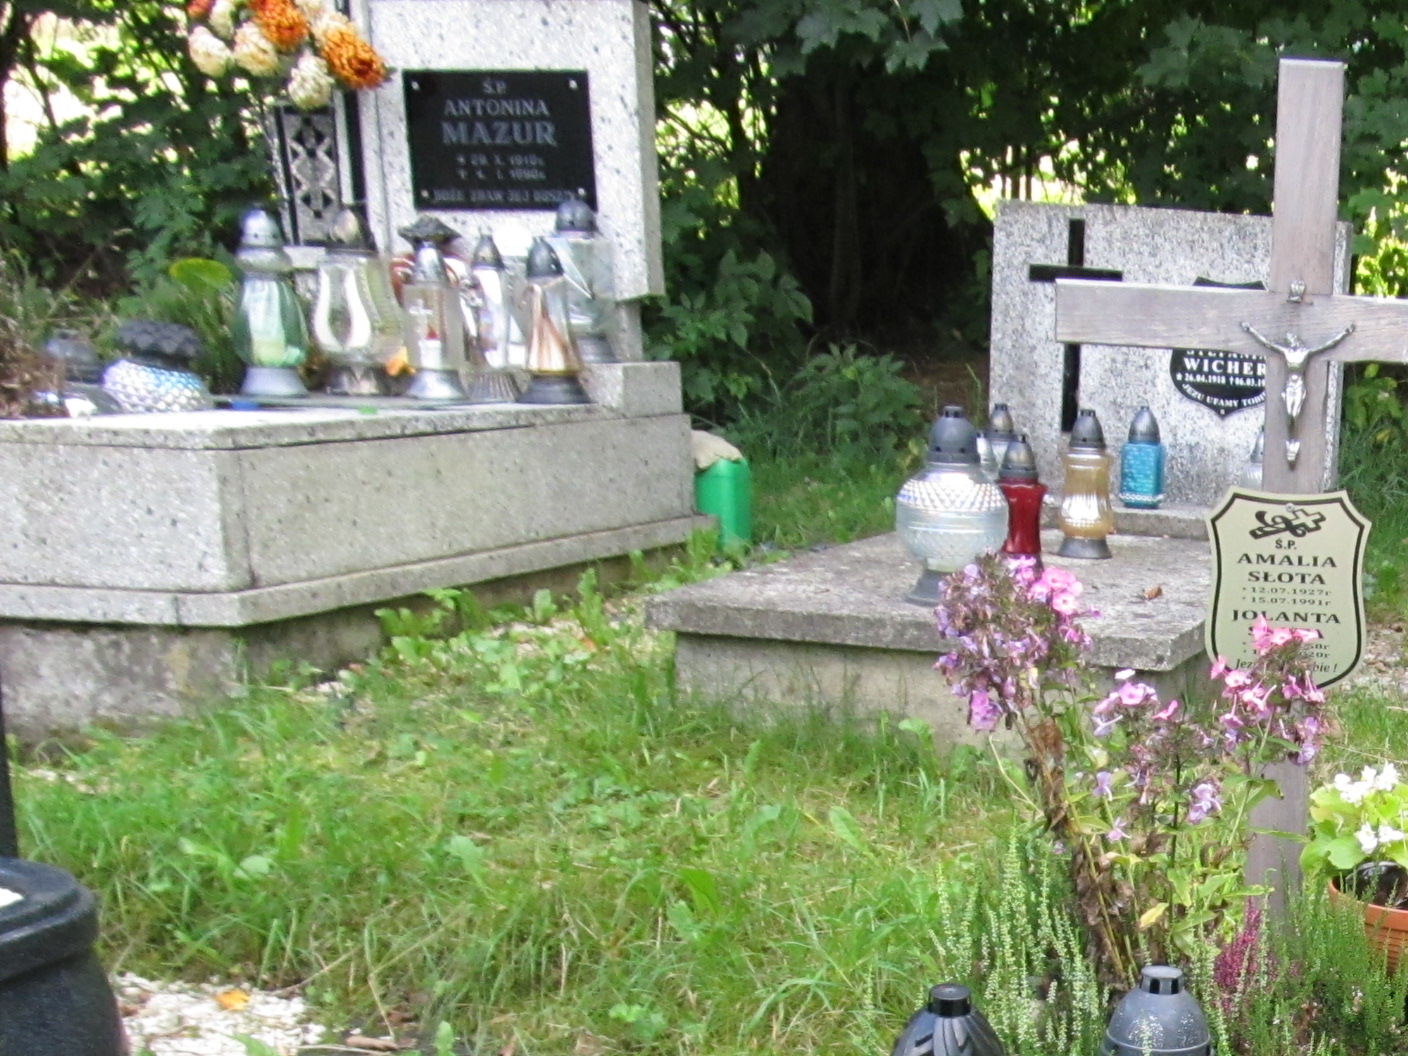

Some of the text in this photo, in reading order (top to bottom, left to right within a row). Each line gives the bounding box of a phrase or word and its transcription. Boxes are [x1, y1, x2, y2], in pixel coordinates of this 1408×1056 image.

[444, 99, 549, 117] ANTONINA
[441, 120, 558, 147] MAZUR
[1182, 383, 1205, 401] JEZU
[1206, 395, 1239, 407] UFAMY
[1237, 553, 1337, 568] AMALIA
[1248, 571, 1326, 585] SŁOTA
[1232, 609, 1341, 624] JOLANTA
